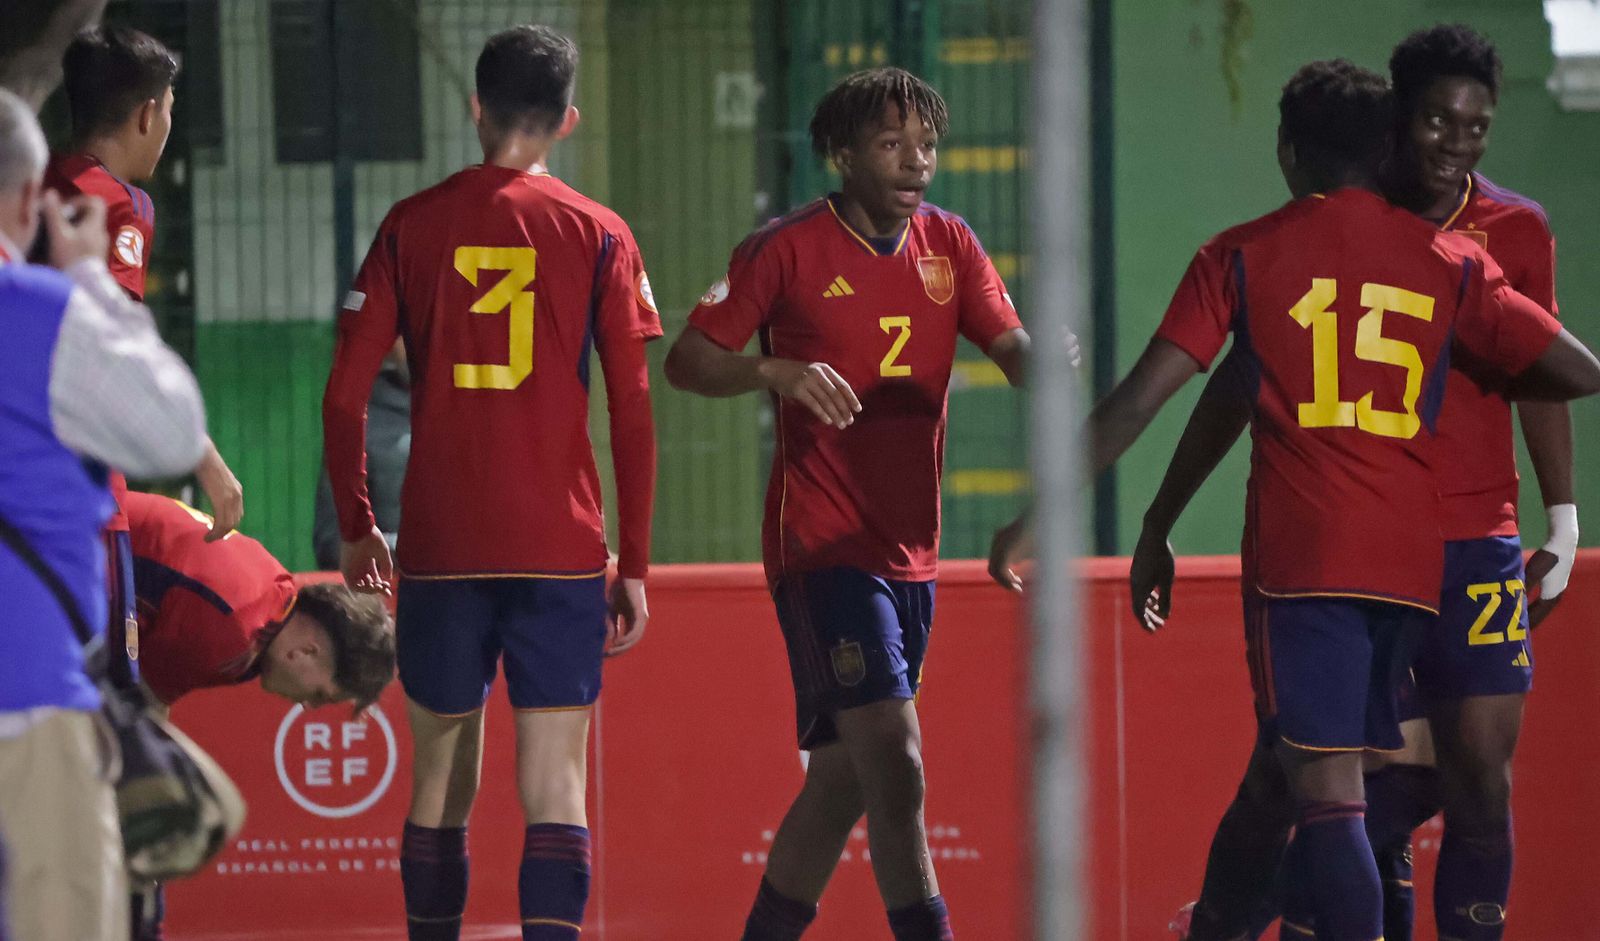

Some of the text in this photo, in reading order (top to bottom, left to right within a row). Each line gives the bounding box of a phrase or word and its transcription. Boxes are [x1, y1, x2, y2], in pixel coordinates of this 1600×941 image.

[454, 246, 536, 390] 3
[879, 316, 912, 377] 2
[1288, 278, 1435, 439] 15
[1466, 579, 1527, 646] 22
[236, 837, 398, 852] REAL FEDERAC
[338, 859, 364, 872] DE
